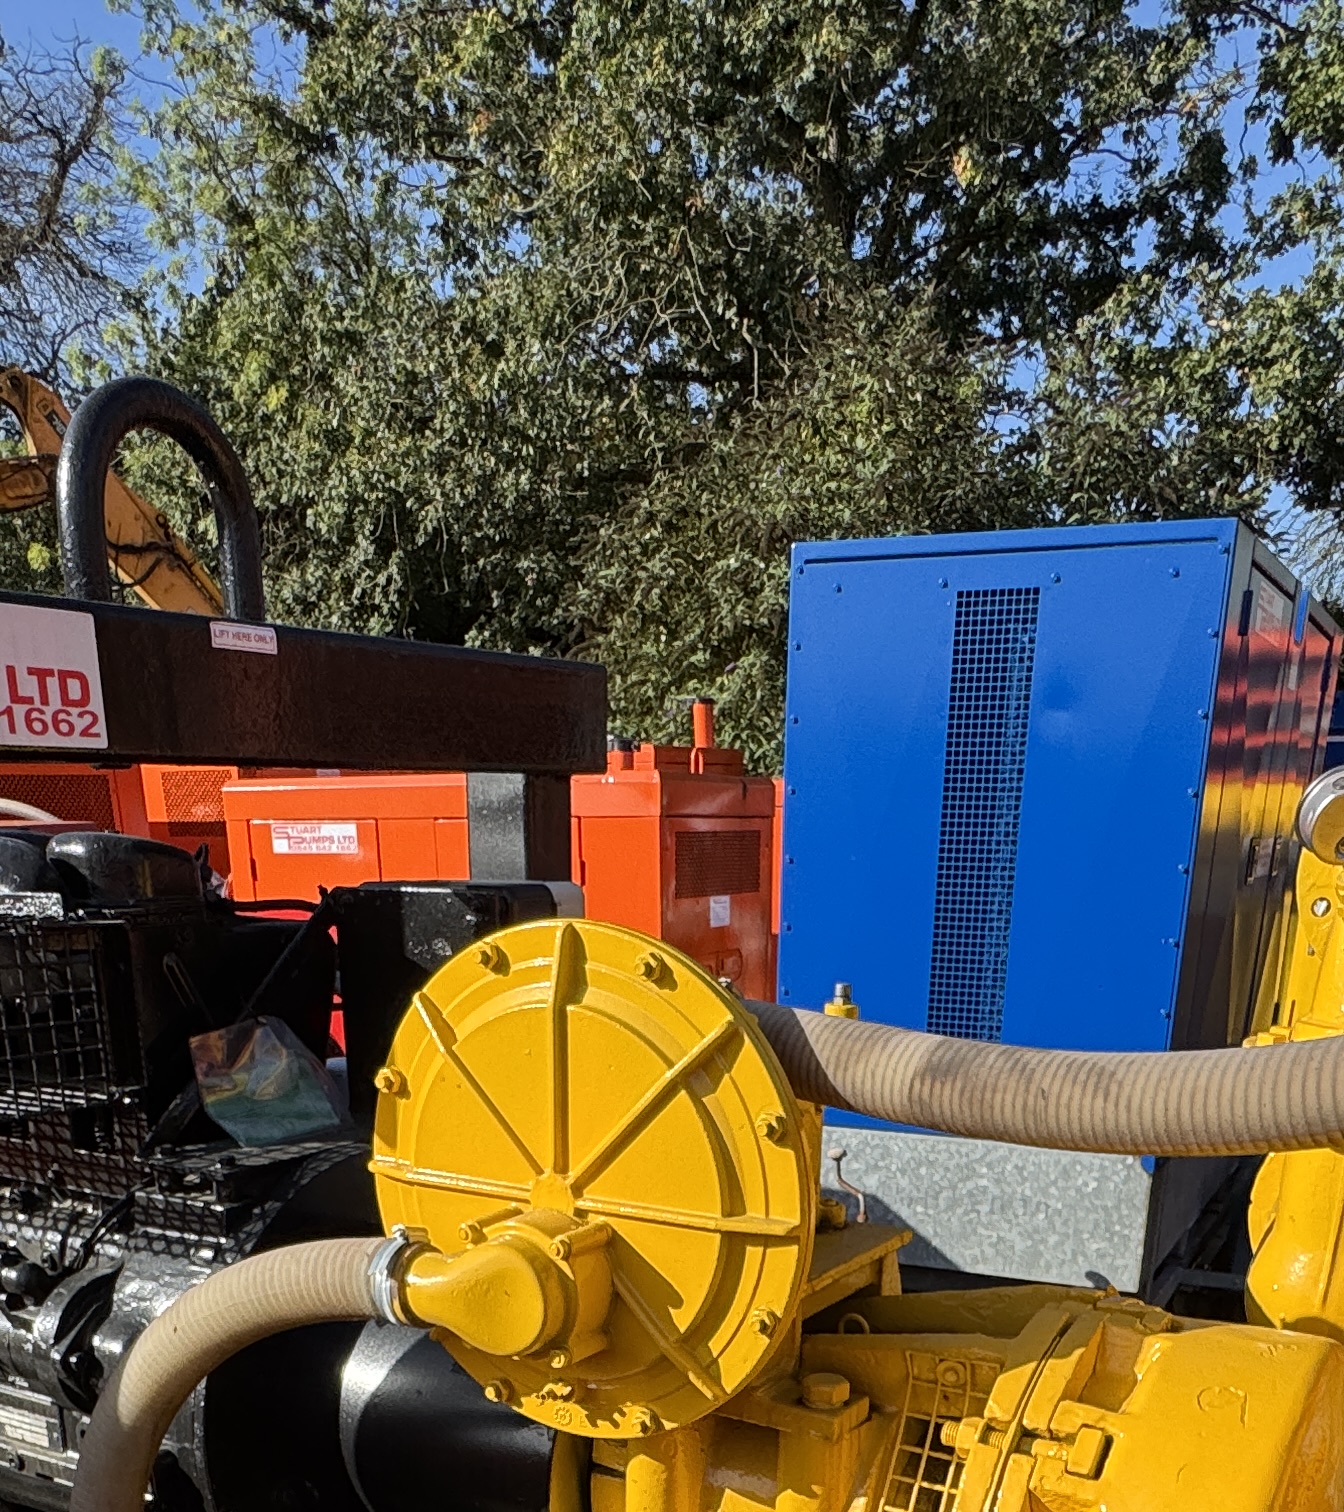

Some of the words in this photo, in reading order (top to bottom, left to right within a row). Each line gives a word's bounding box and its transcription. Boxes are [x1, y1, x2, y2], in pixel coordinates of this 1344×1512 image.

[213, 628, 230, 639] LIFT
[6, 664, 92, 708] LTD
[273, 826, 322, 835] STUART
[338, 835, 355, 845] LTD
